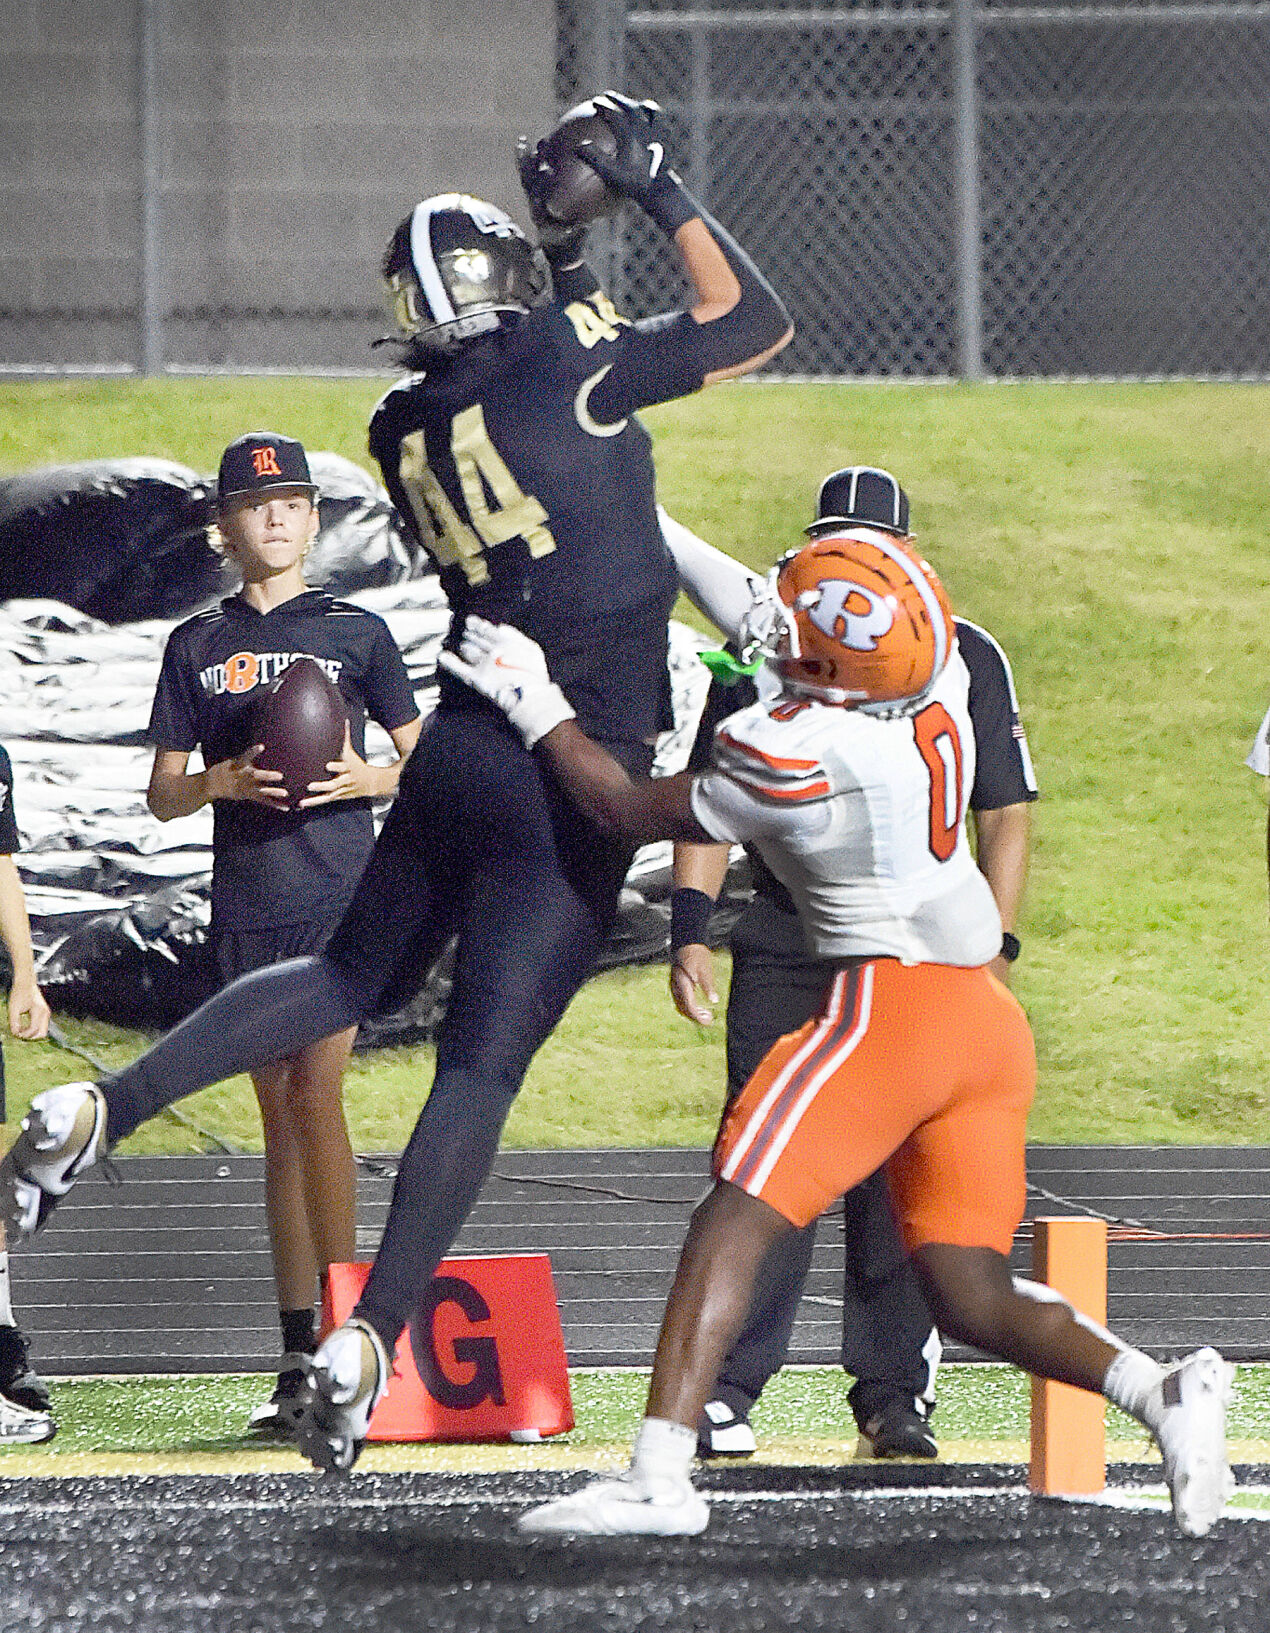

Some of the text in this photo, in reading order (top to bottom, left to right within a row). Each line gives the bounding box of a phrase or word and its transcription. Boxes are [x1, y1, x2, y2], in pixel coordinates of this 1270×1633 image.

[251, 446, 282, 476] R
[399, 404, 558, 587] 44
[808, 578, 895, 652] R
[913, 701, 963, 863] 0
[410, 1276, 508, 1410] G
